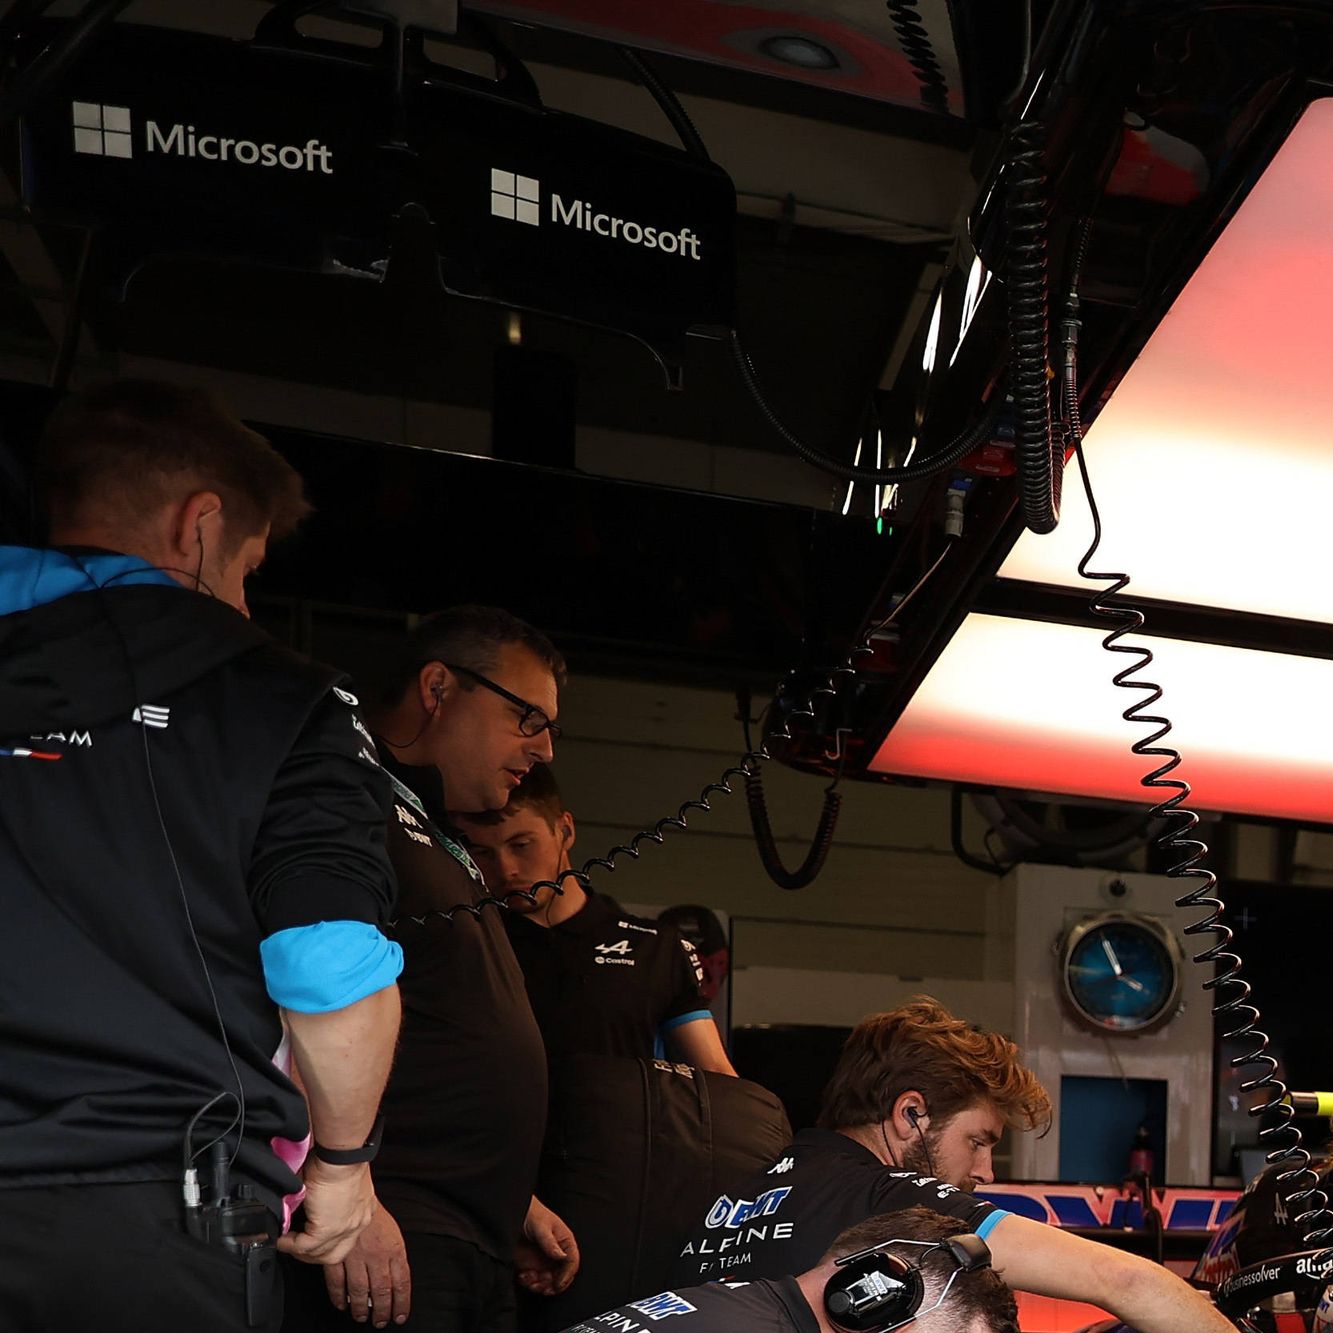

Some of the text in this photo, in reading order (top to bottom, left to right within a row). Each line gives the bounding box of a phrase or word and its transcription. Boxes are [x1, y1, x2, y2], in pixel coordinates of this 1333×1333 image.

[145, 121, 333, 175] Microsoft
[551, 194, 701, 260] Microsoft
[605, 957, 636, 967] Castrol
[719, 1252, 752, 1270] TEAM
